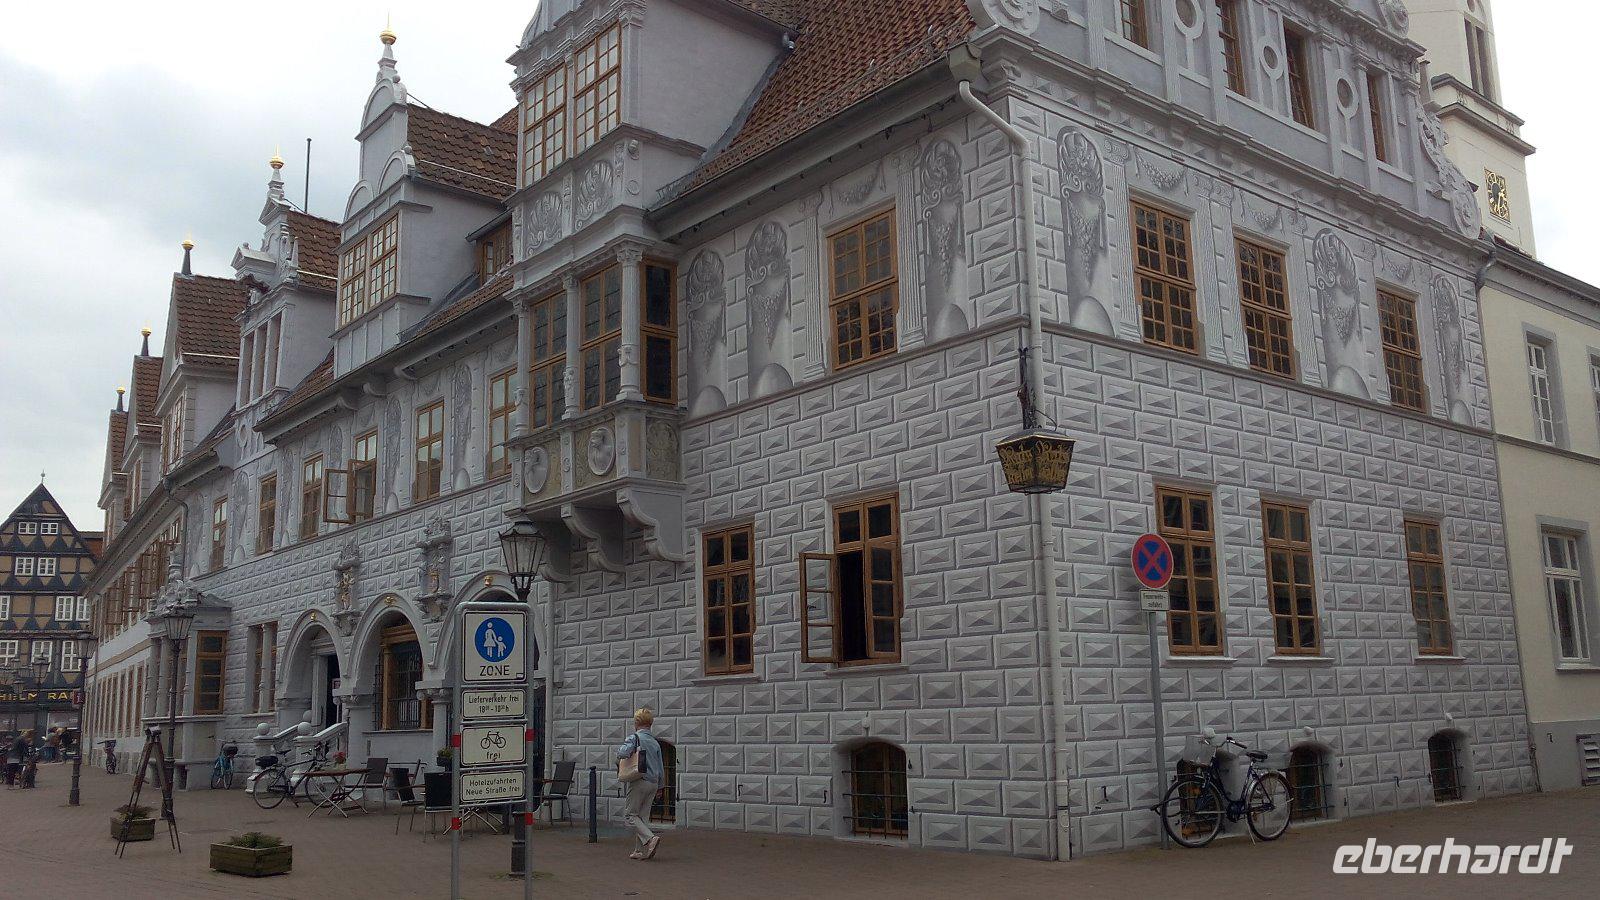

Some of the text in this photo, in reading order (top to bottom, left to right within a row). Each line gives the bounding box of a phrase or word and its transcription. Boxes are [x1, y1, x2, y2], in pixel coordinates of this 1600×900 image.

[480, 665, 510, 676] ZONE
[468, 694, 520, 704] Lieferverkehr frei
[486, 751, 501, 760] frei
[469, 777, 517, 788] Hotelzufahrten
[465, 788, 483, 796] Neue
[508, 785, 520, 793] frei
